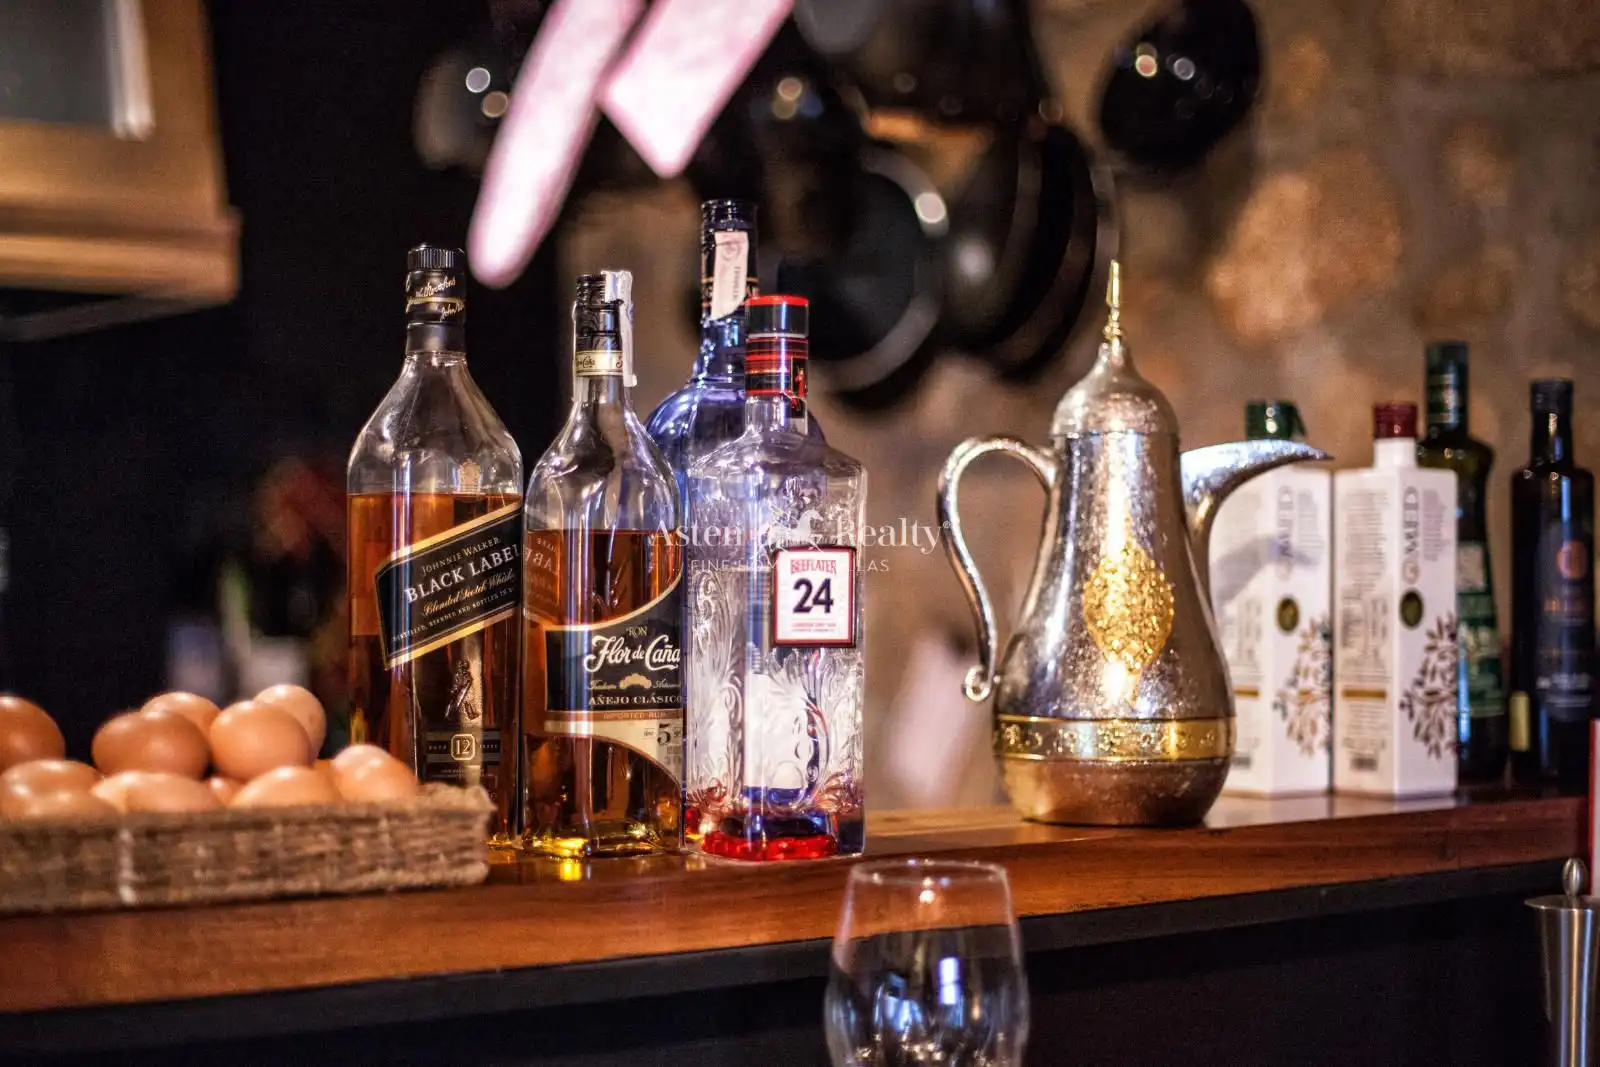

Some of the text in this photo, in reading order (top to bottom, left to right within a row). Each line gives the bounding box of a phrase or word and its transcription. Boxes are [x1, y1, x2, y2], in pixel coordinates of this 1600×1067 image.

[421, 536, 500, 576] JOHNNIE WALKER
[404, 567, 465, 603] BLACK
[793, 577, 834, 614] 24
[627, 627, 648, 639] RON
[583, 634, 680, 672] Flor de Caña
[588, 694, 630, 706] AÑEJO
[456, 739, 471, 755] 12
[657, 723, 671, 745] 5
